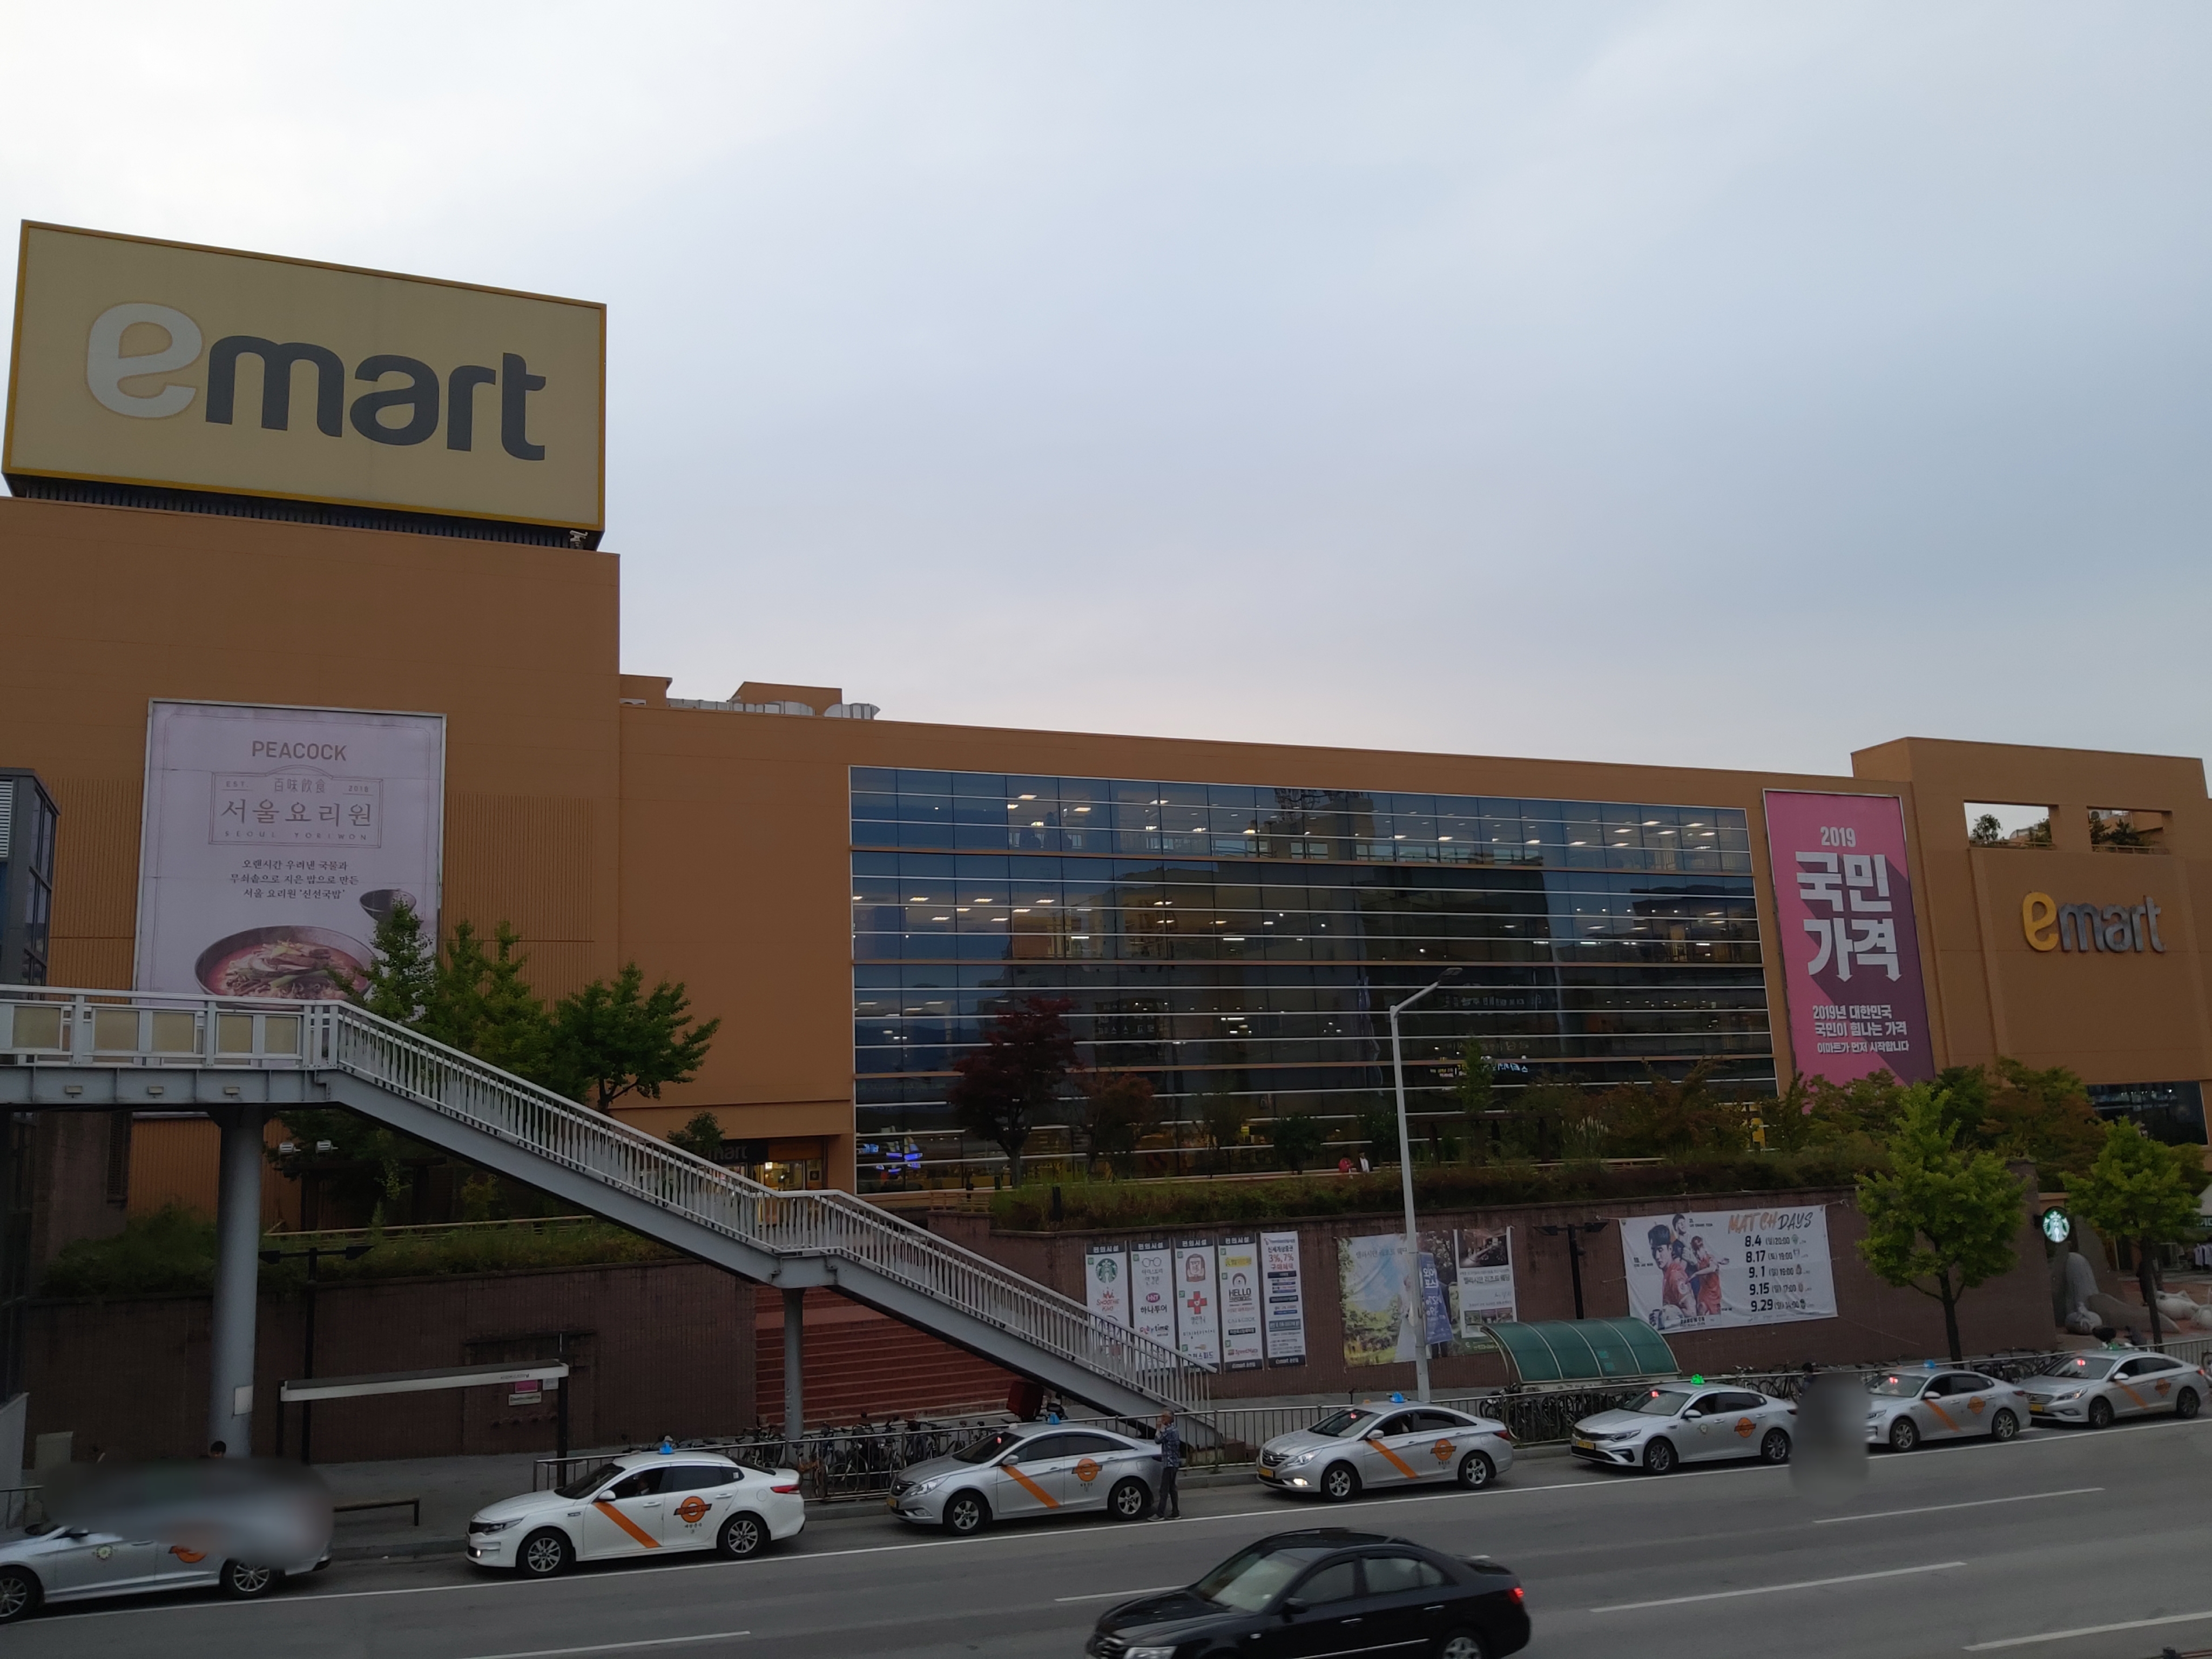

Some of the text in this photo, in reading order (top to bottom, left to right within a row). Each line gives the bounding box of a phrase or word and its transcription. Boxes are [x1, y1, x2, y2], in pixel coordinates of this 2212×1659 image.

[84, 301, 547, 461] emart
[252, 740, 347, 761] PEACOCK
[274, 778, 325, 793] 百味飲食
[221, 799, 370, 827] 서울요리원
[294, 832, 366, 841] YORIWON
[1820, 826, 1856, 847] 2019
[241, 859, 349, 871] 오랜시간 우려낸 국물과
[230, 874, 359, 886] 무쇠솥으로 지은 밥으로 만든
[1795, 851, 1892, 912] 국민
[244, 888, 264, 898] 서울
[267, 889, 296, 899] 요리원
[2022, 892, 2168, 953] emart
[1803, 918, 1902, 982] 가격
[1812, 1004, 1892, 1020] 2019년 대한민국
[1815, 1021, 1907, 1037] 국민이 힘나는 가격
[1817, 1040, 1910, 1053] 이마트가 먼저 시작합니다
[707, 1144, 748, 1161] mart
[1728, 1211, 1778, 1234] MATCH
[1777, 1211, 1813, 1231] DAYS
[1745, 1235, 1762, 1247] 8.4
[1746, 1250, 1765, 1263] 8.17
[1229, 1288, 1251, 1297] HELLO
[1749, 1282, 1769, 1295] 9.15
[1140, 1304, 1168, 1314] 하나투어
[1751, 1299, 1773, 1312] 9.29
